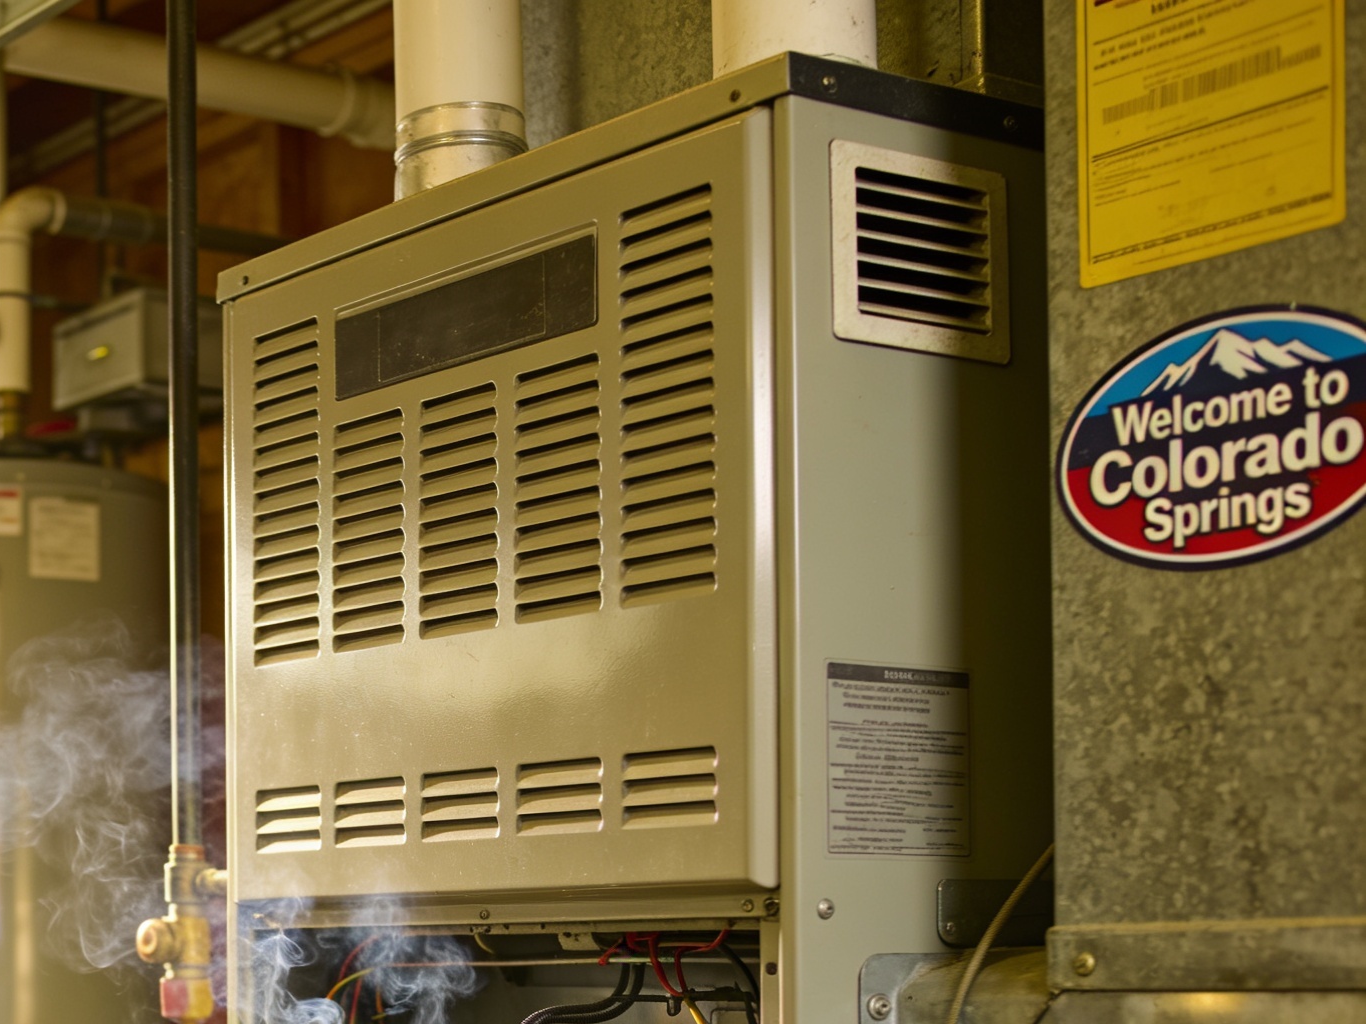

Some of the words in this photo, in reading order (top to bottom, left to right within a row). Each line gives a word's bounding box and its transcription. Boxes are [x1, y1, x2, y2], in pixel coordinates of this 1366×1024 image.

[1113, 383, 1293, 445] Welcome
[1302, 366, 1349, 407] to
[1090, 412, 1365, 505] Colorado
[1144, 482, 1312, 548] Springs
